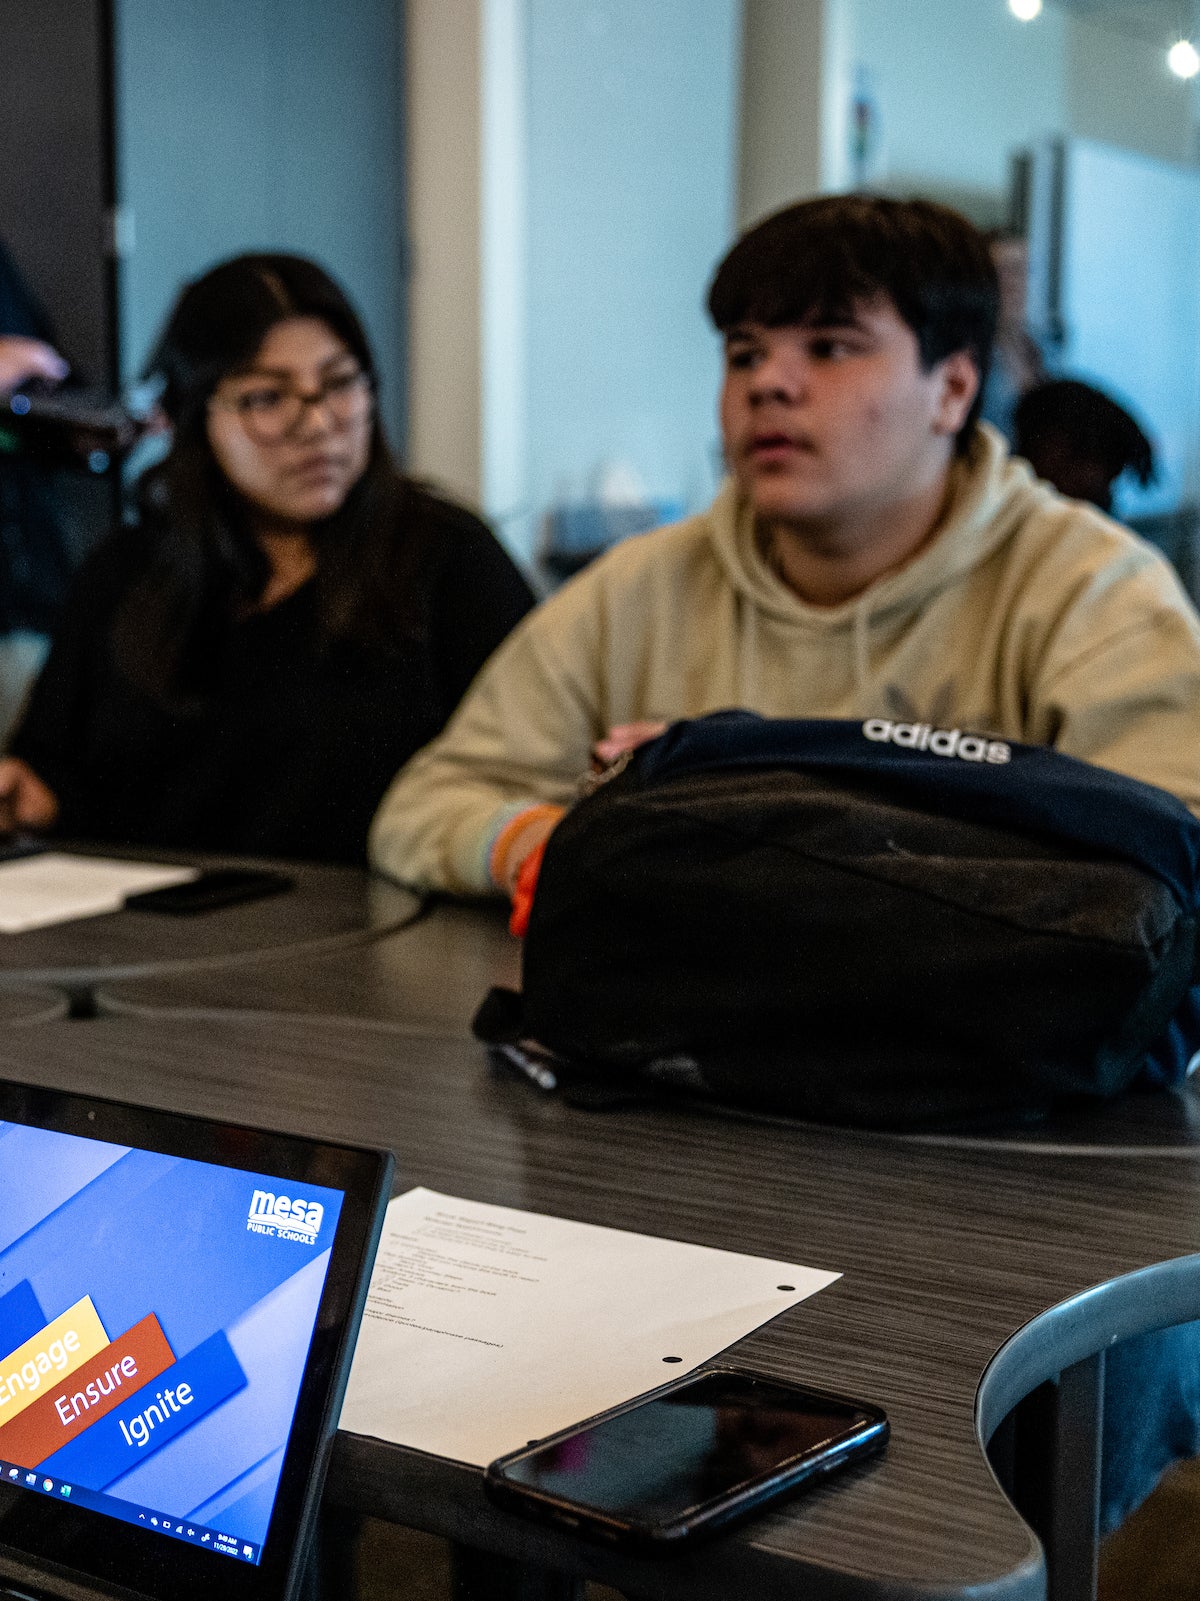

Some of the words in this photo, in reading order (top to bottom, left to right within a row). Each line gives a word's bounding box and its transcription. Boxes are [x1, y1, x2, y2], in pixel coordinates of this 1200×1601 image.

[862, 718, 1011, 764] adidas
[246, 1222, 276, 1236] PUBLIC
[277, 1229, 317, 1246] SCHOOLS
[248, 1190, 324, 1233] mesa
[54, 1355, 138, 1426] Ensure
[118, 1382, 194, 1446] Ignite
